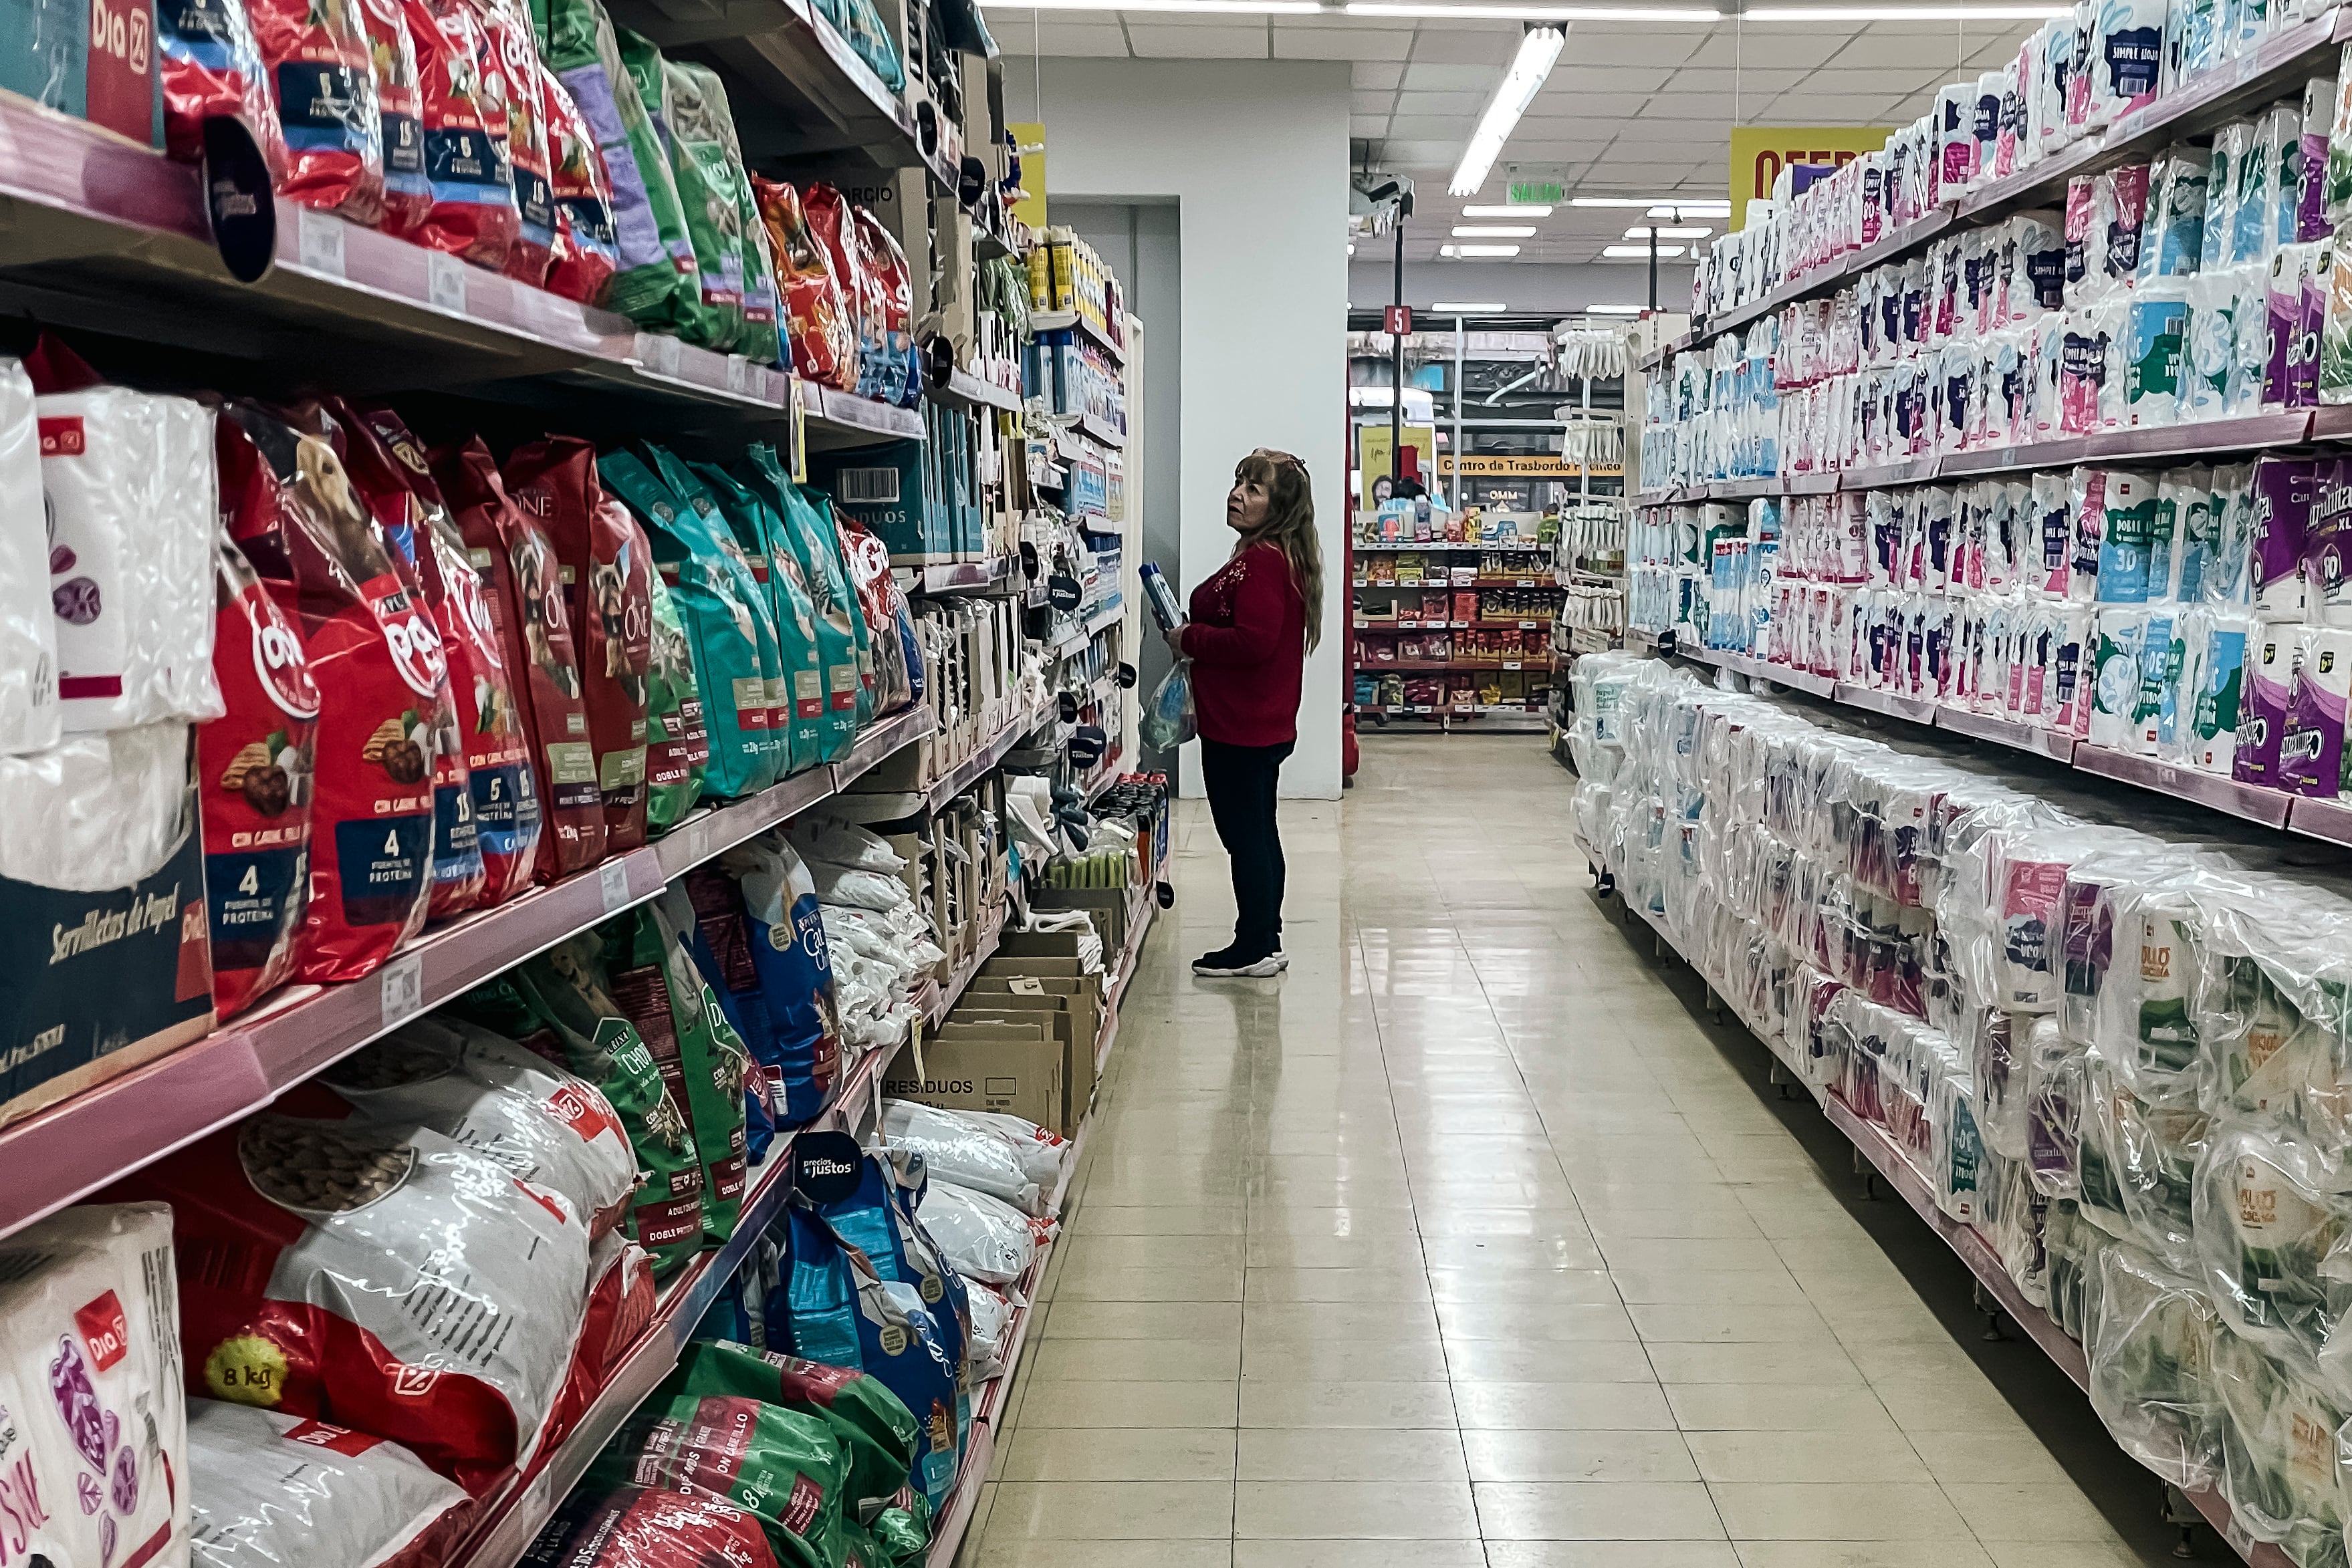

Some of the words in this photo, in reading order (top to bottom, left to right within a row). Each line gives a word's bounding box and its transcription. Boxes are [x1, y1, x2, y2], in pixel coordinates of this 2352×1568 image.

[1394, 308, 1403, 333] 5
[1443, 459, 1485, 471] Cntro
[1508, 460, 1570, 471] Trasbordo
[2338, 517, 2352, 531] XL
[2115, 549, 2137, 571] 30
[384, 829, 400, 858] 4
[239, 864, 259, 896] 4
[803, 927, 826, 957] Cat
[713, 1065, 726, 1081] CON
[886, 1079, 973, 1094] RESIDUOS
[644, 1109, 659, 1126] CON
[804, 1158, 832, 1168] precios
[811, 1162, 851, 1178] justos
[223, 1367, 237, 1386] 8
[243, 1365, 271, 1390] kg
[742, 1488, 760, 1510] 8
